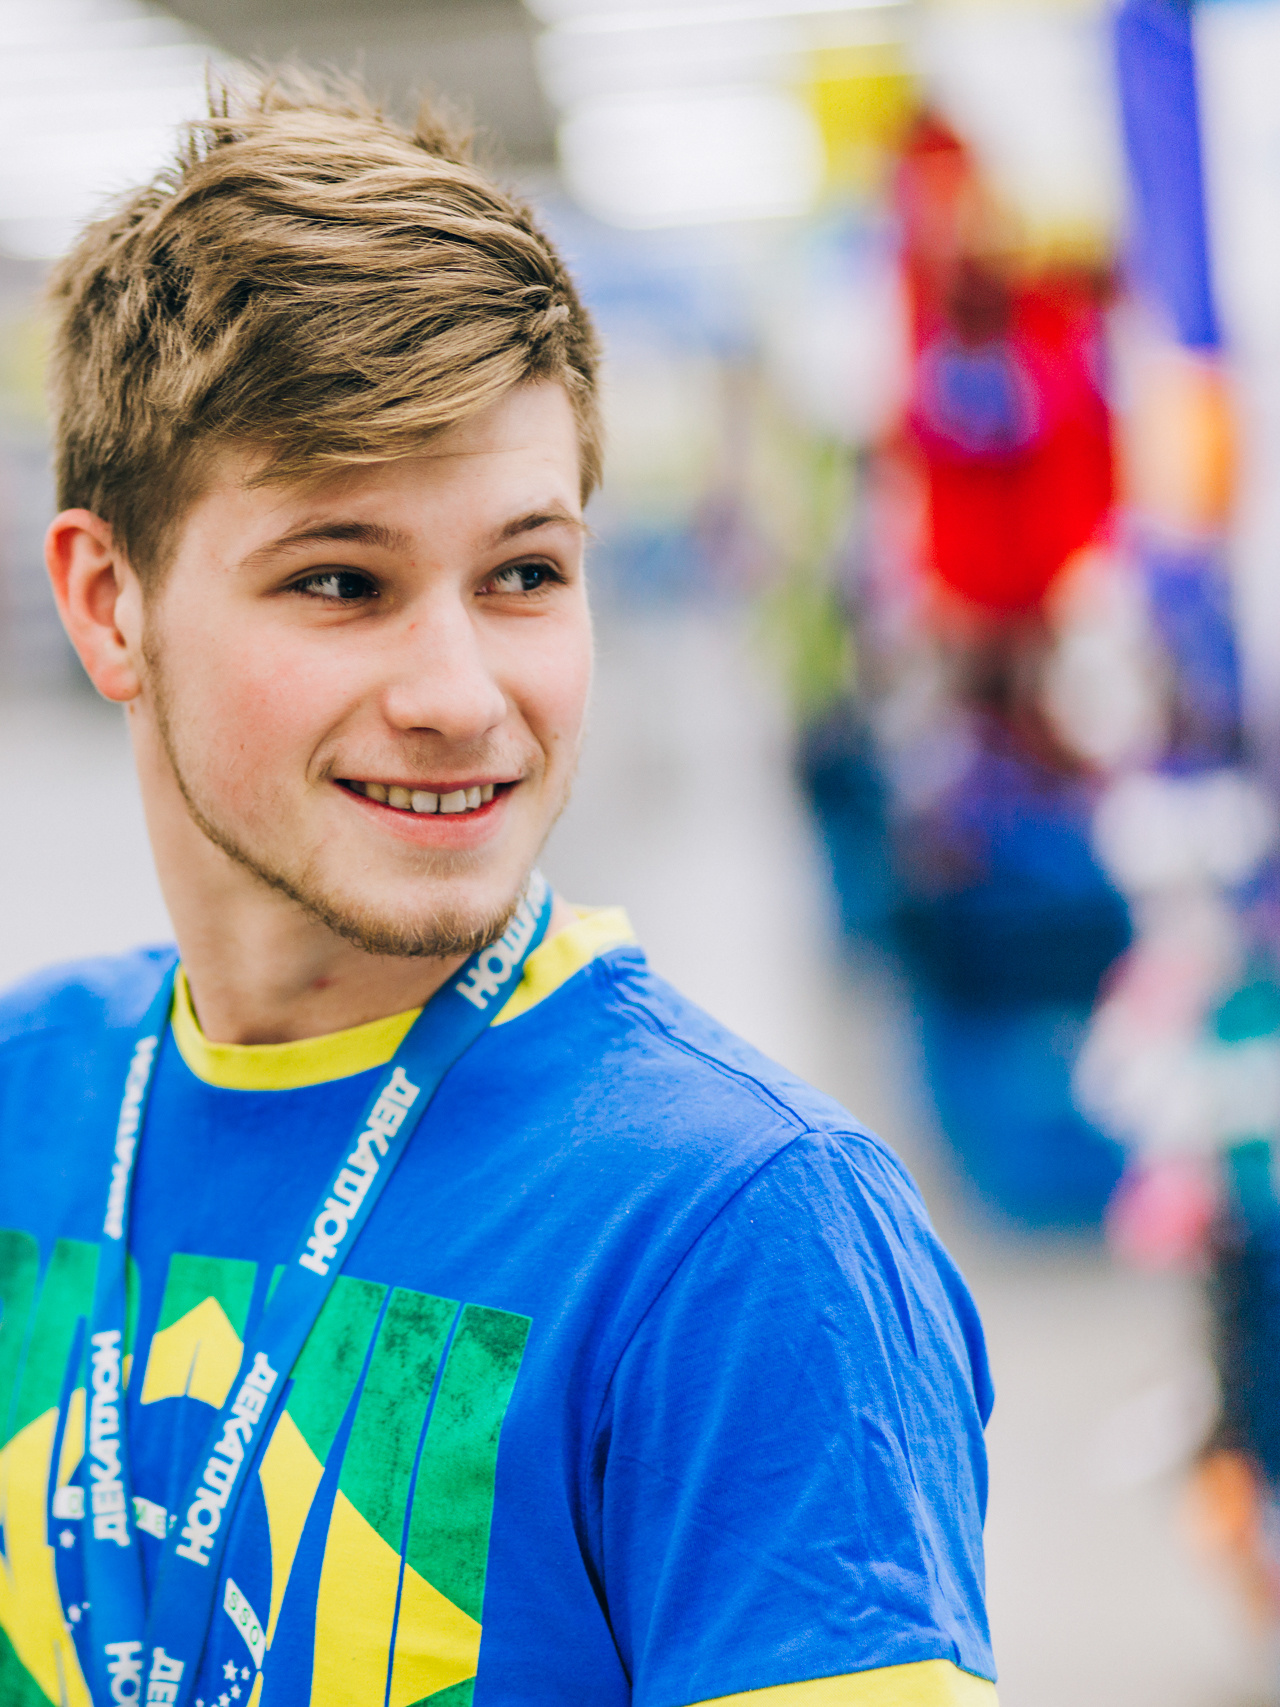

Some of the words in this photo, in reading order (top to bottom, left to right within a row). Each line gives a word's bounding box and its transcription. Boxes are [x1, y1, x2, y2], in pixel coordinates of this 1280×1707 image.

[299, 1066, 420, 1276] ДЕКАТЛОН
[89, 1330, 131, 1547] ДЕКАТЛОН
[175, 1352, 278, 1566] ДЕКАТЛОН
